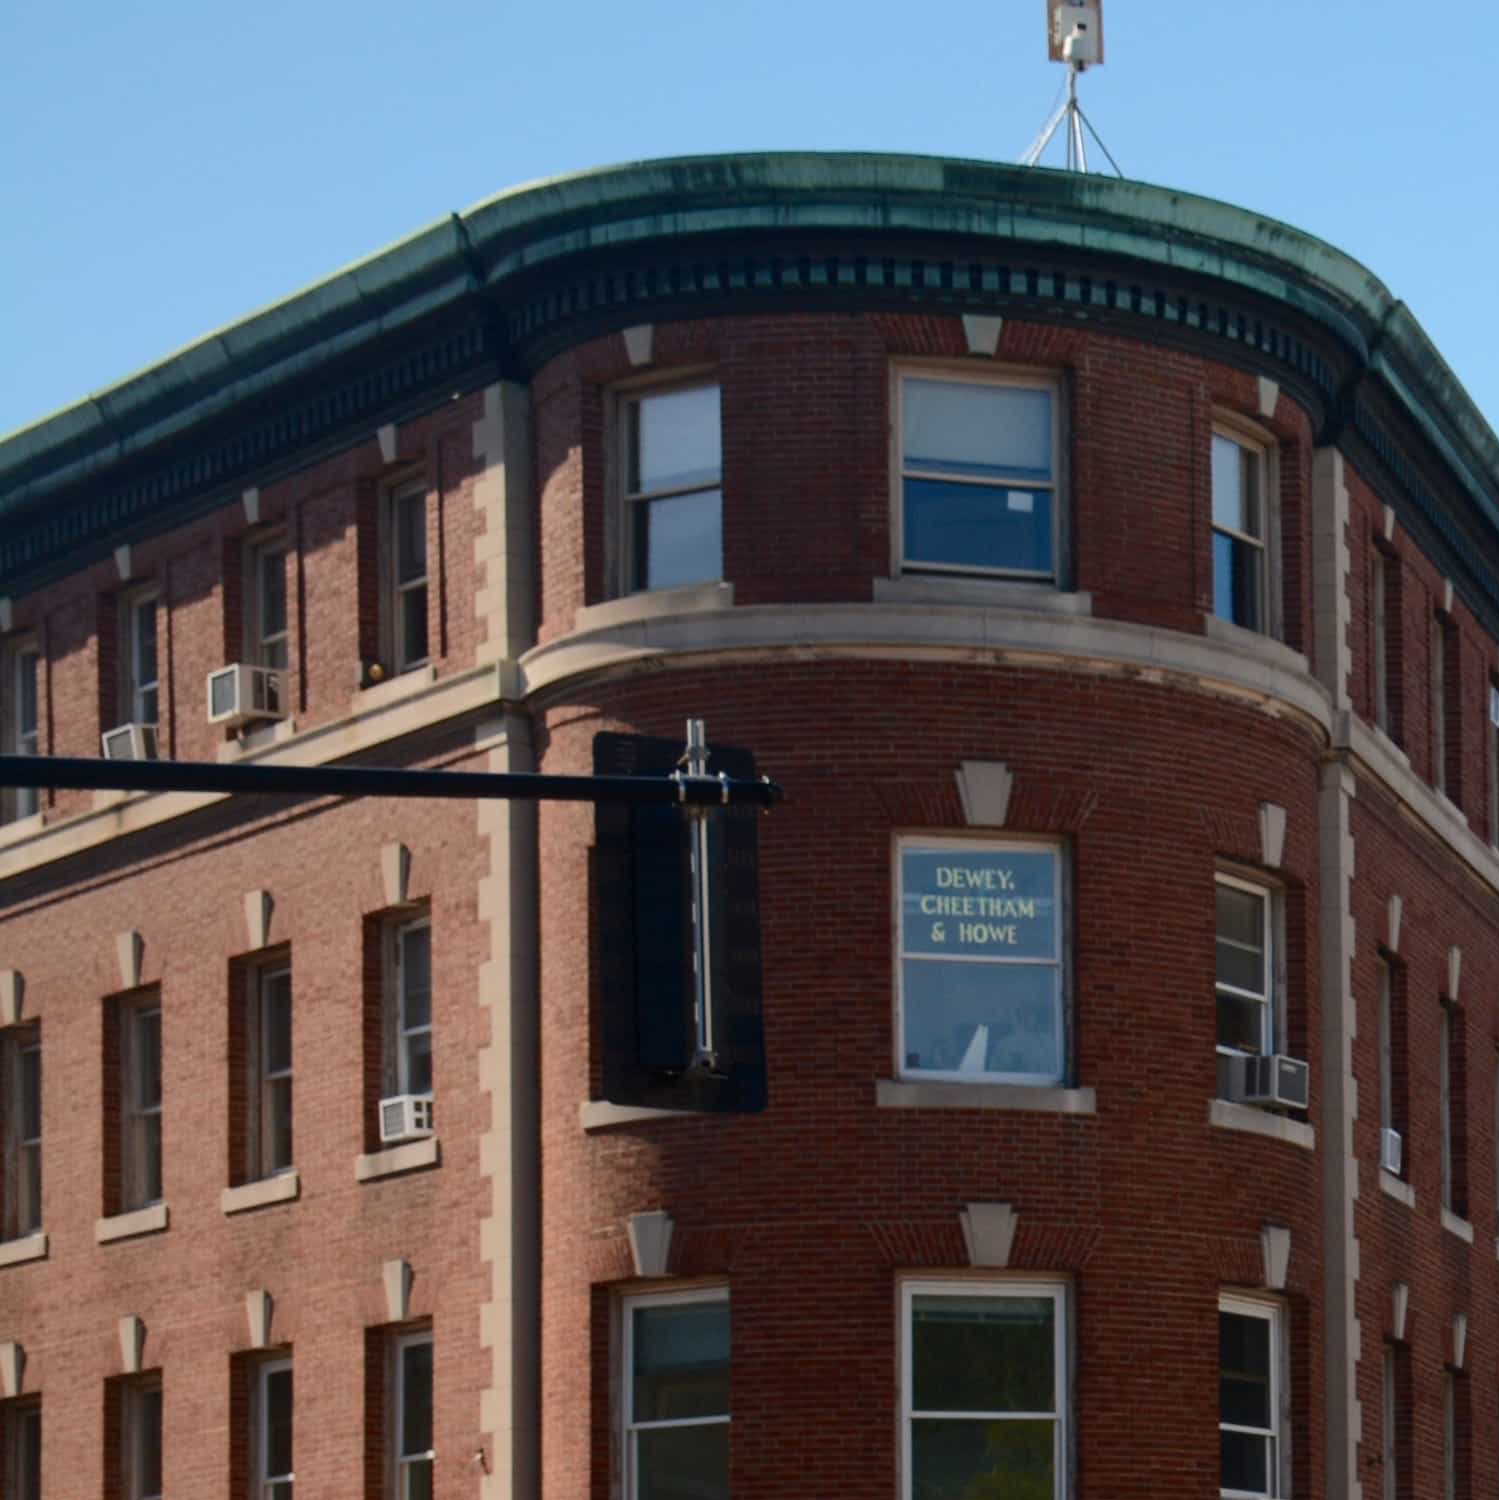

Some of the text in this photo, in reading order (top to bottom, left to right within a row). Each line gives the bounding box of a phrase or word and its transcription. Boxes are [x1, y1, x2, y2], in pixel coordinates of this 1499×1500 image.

[920, 894, 1036, 919] CHEETHAM
[930, 921, 1018, 945] & HOWE
